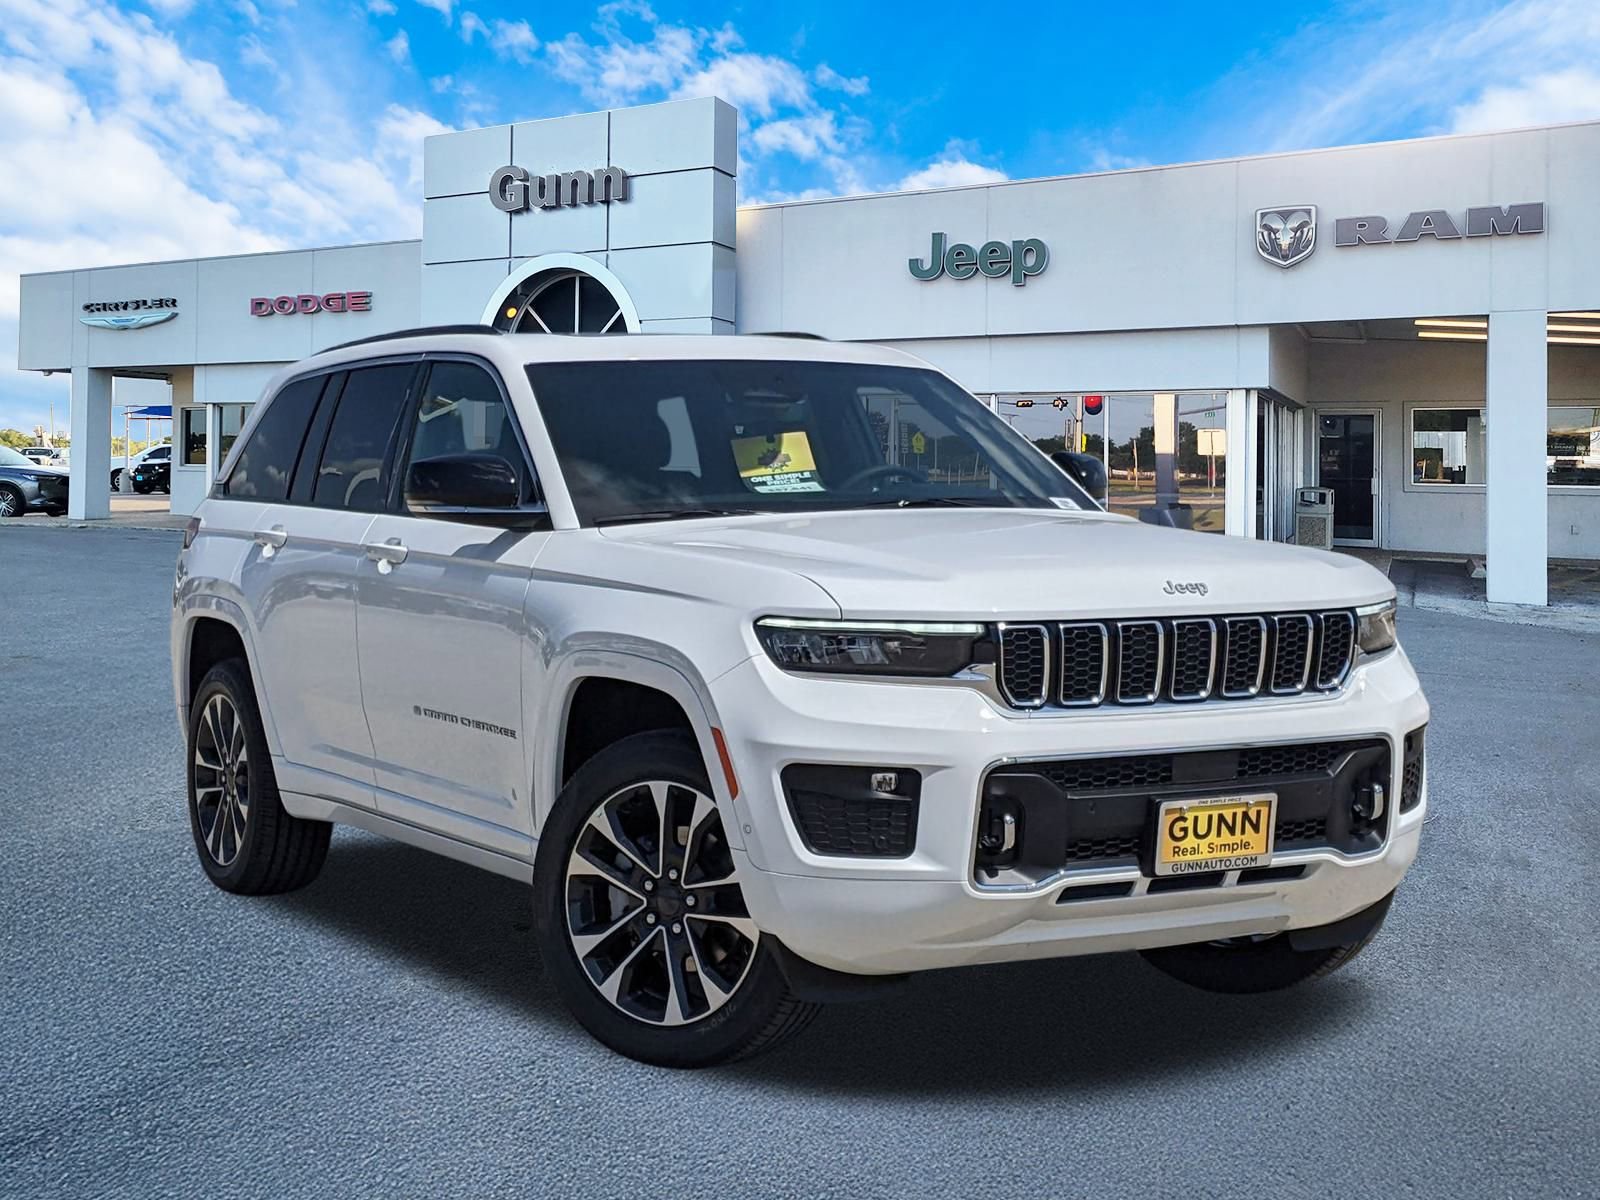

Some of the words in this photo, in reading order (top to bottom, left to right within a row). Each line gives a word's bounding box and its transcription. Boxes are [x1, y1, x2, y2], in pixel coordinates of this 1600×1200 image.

[489, 165, 628, 212] Gunn
[1335, 202, 1545, 247] RAM
[908, 232, 1050, 286] Jeep
[82, 298, 178, 313] CHRYSLER
[250, 292, 373, 316] DODGE
[773, 472, 811, 480] SIMPLE
[1163, 580, 1208, 597] Jeep
[1168, 809, 1262, 842] GUNN
[1172, 843, 1203, 857] Real.
[1171, 856, 1258, 873] GUNNAUTO.COM
